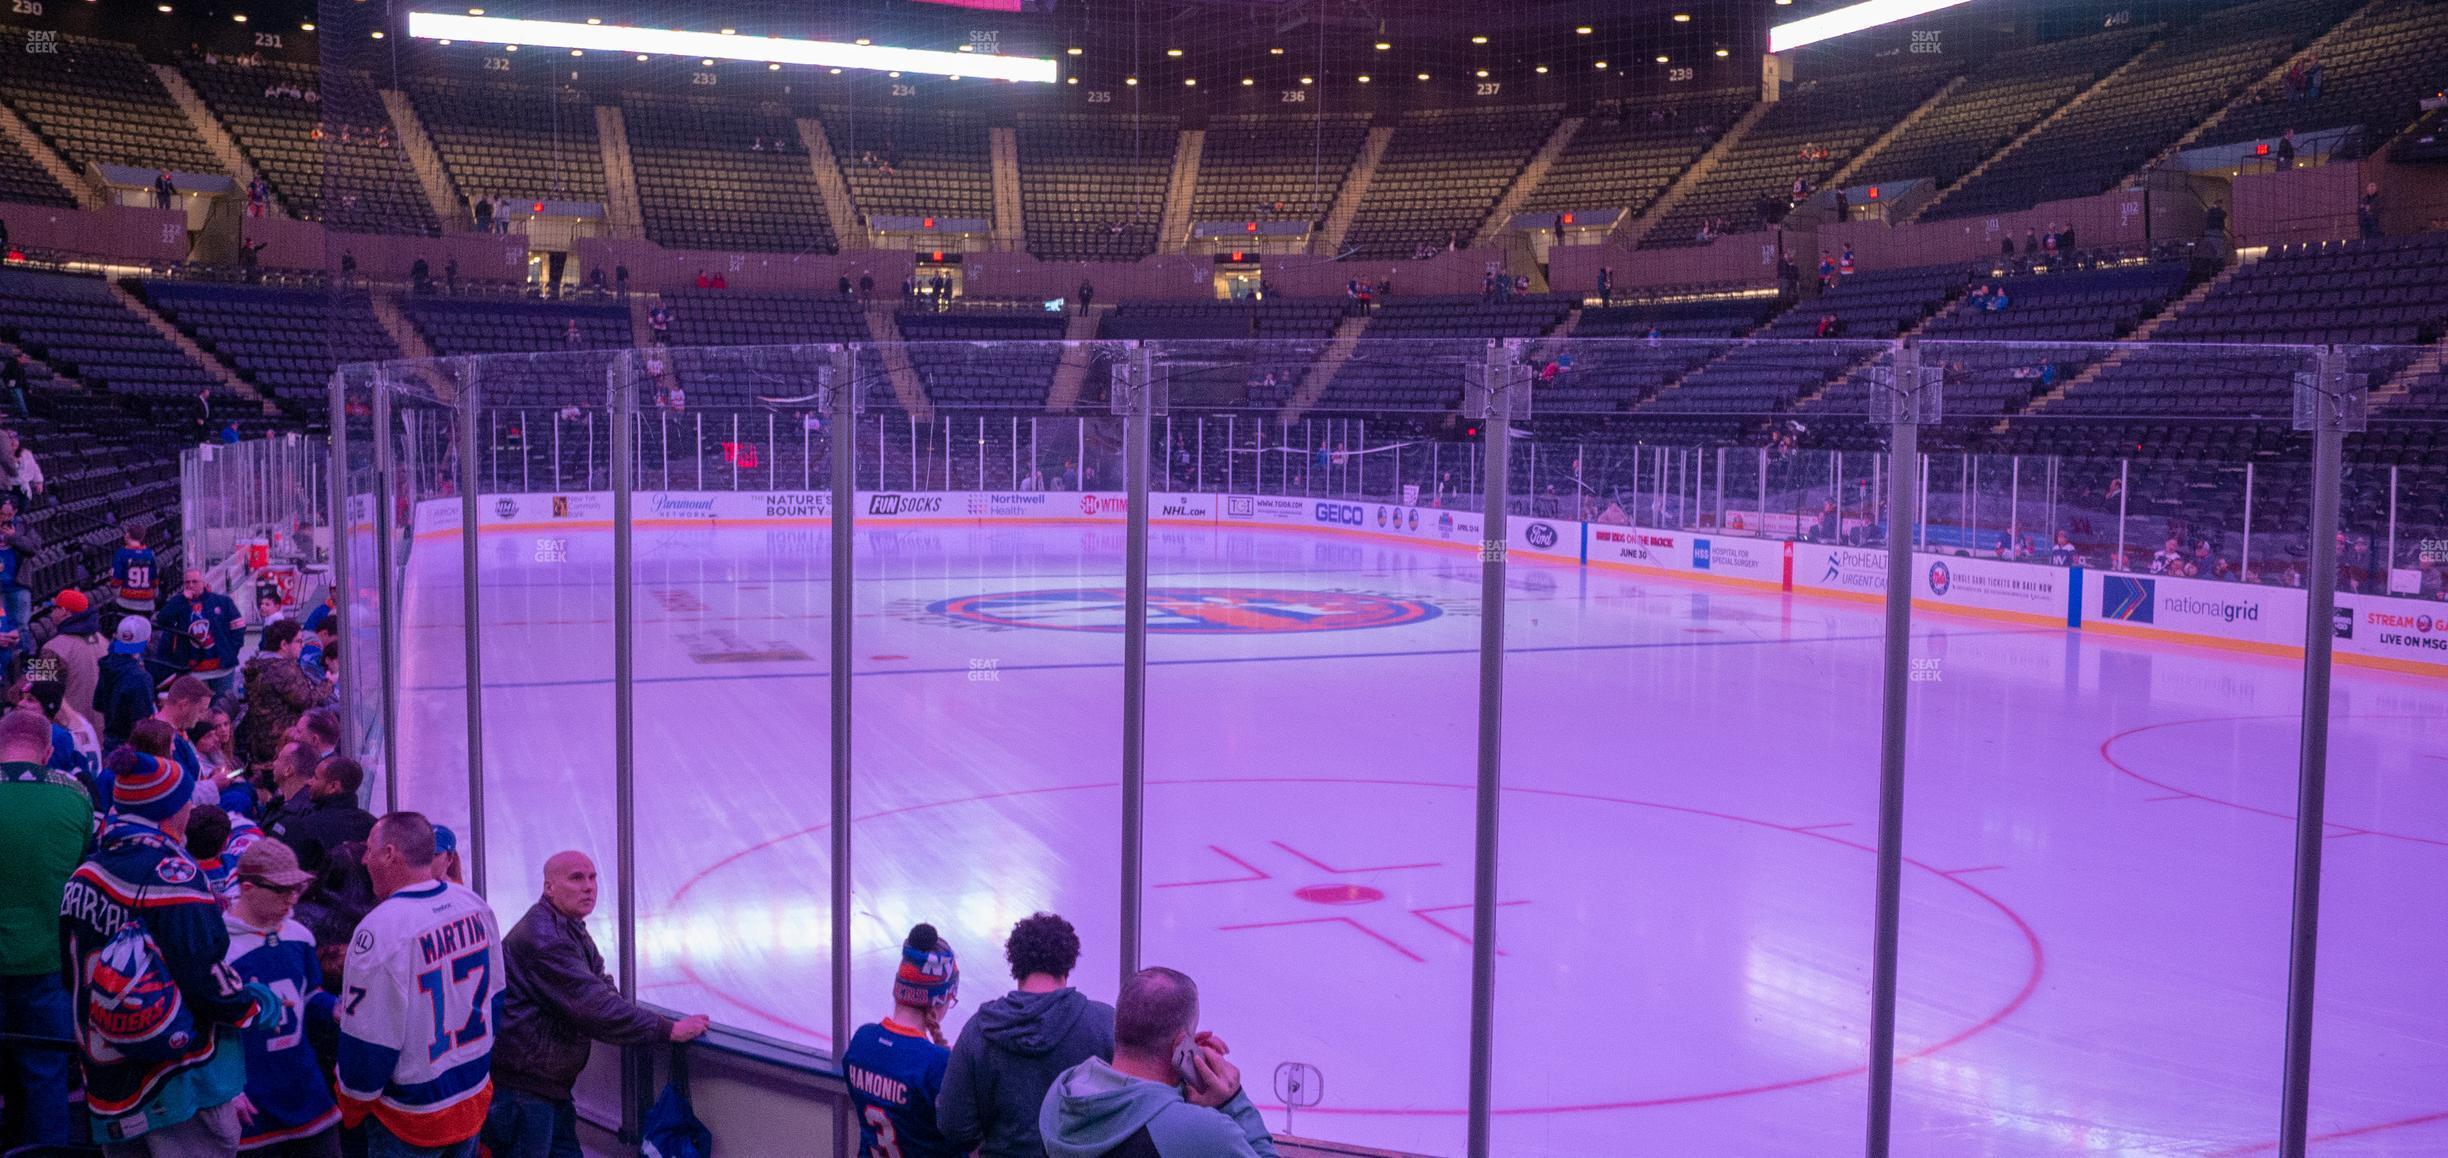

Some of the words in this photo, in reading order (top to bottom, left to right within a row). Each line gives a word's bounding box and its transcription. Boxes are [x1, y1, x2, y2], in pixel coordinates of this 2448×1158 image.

[12, 0, 43, 16] 230
[255, 32, 283, 48] 231
[483, 57, 510, 71] 232
[692, 72, 717, 85] 233
[892, 84, 916, 96] 234
[1088, 91, 1111, 103] 235
[1282, 91, 1305, 102] 236
[1477, 83, 1501, 95] 237
[650, 494, 713, 512] Paramount
[766, 495, 831, 505] NATURE'S
[871, 496, 899, 513] FUN
[899, 497, 942, 512] SOCKS
[991, 494, 1045, 504] Northwell
[1080, 495, 1127, 515] SHOWTIM
[766, 506, 825, 516] BOUNTY
[991, 505, 1025, 516] Health
[1163, 505, 1205, 517] NHL.COM
[1315, 503, 1363, 525] GEICO
[1529, 525, 1552, 548] Ford
[1620, 549, 1637, 558] JUNE
[1639, 550, 1647, 559] 30
[1842, 552, 1887, 569] ProHEALT
[127, 566, 150, 588] 91
[1842, 574, 1873, 587] URGENT
[2165, 596, 2258, 622] nationalgrid
[2368, 613, 2414, 628] STREAM
[2435, 619, 2448, 631] GA
[2380, 633, 2402, 645] LIVE
[2403, 637, 2420, 648] ON
[2422, 638, 2448, 650] MSG
[60, 882, 129, 937] BARZA
[418, 912, 487, 966] MARTIN
[345, 986, 367, 1007] 7
[416, 943, 492, 1064] 17
[849, 1064, 907, 1105] HAMONIC
[864, 1104, 903, 1158] 3
